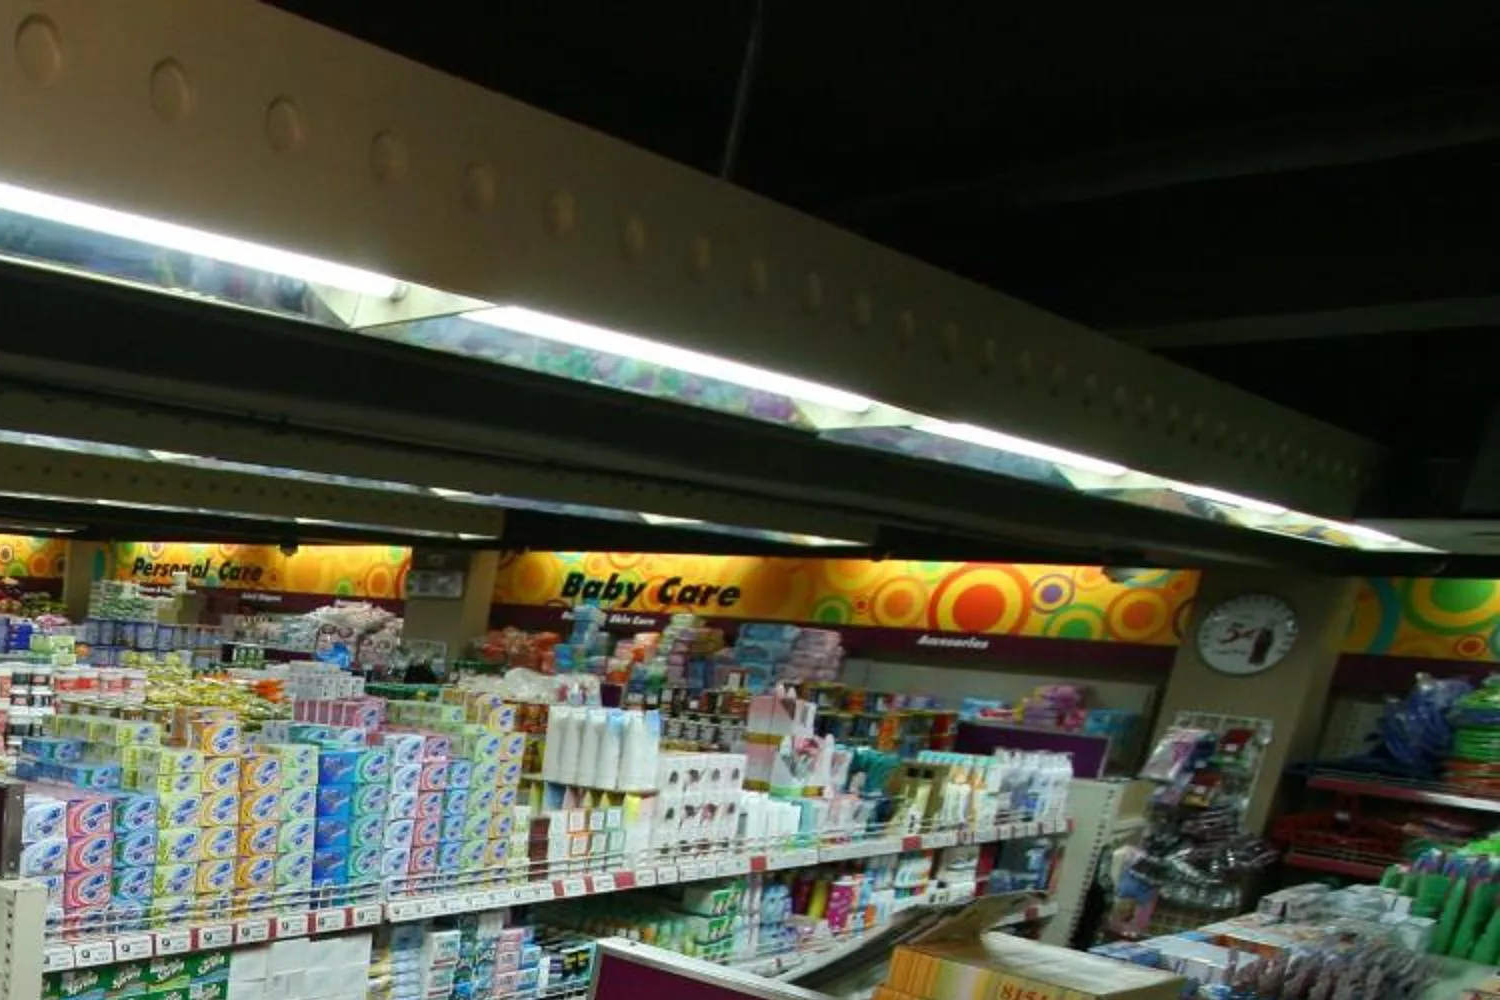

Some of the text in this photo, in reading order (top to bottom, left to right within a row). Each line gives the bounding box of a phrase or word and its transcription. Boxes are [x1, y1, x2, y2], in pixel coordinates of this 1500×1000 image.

[132, 557, 263, 581] Personal Care
[561, 572, 741, 608] Baby Care
